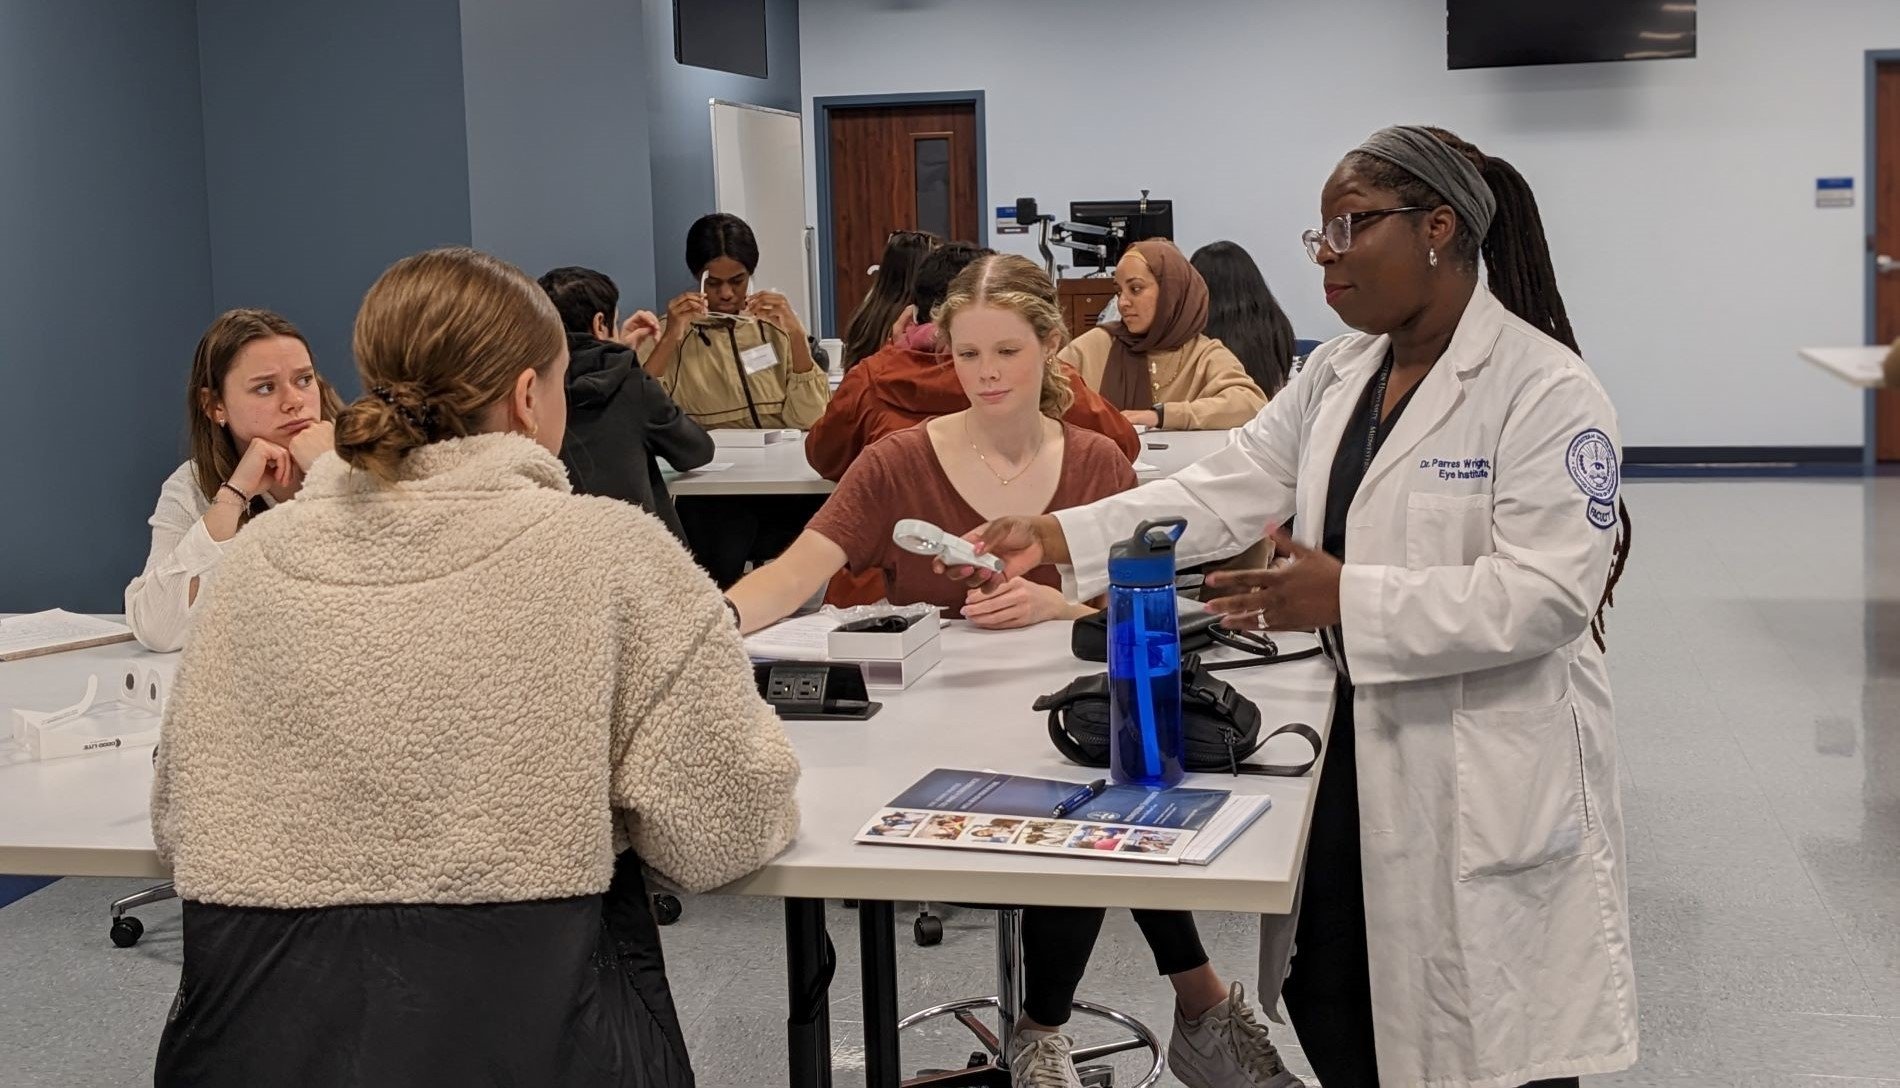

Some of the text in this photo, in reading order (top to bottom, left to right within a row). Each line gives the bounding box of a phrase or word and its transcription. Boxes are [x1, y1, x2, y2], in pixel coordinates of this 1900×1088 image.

[1420, 460, 1430, 468] Dr.
[1432, 459, 1460, 468] Parres
[1439, 470, 1488, 480] Eye Institute
